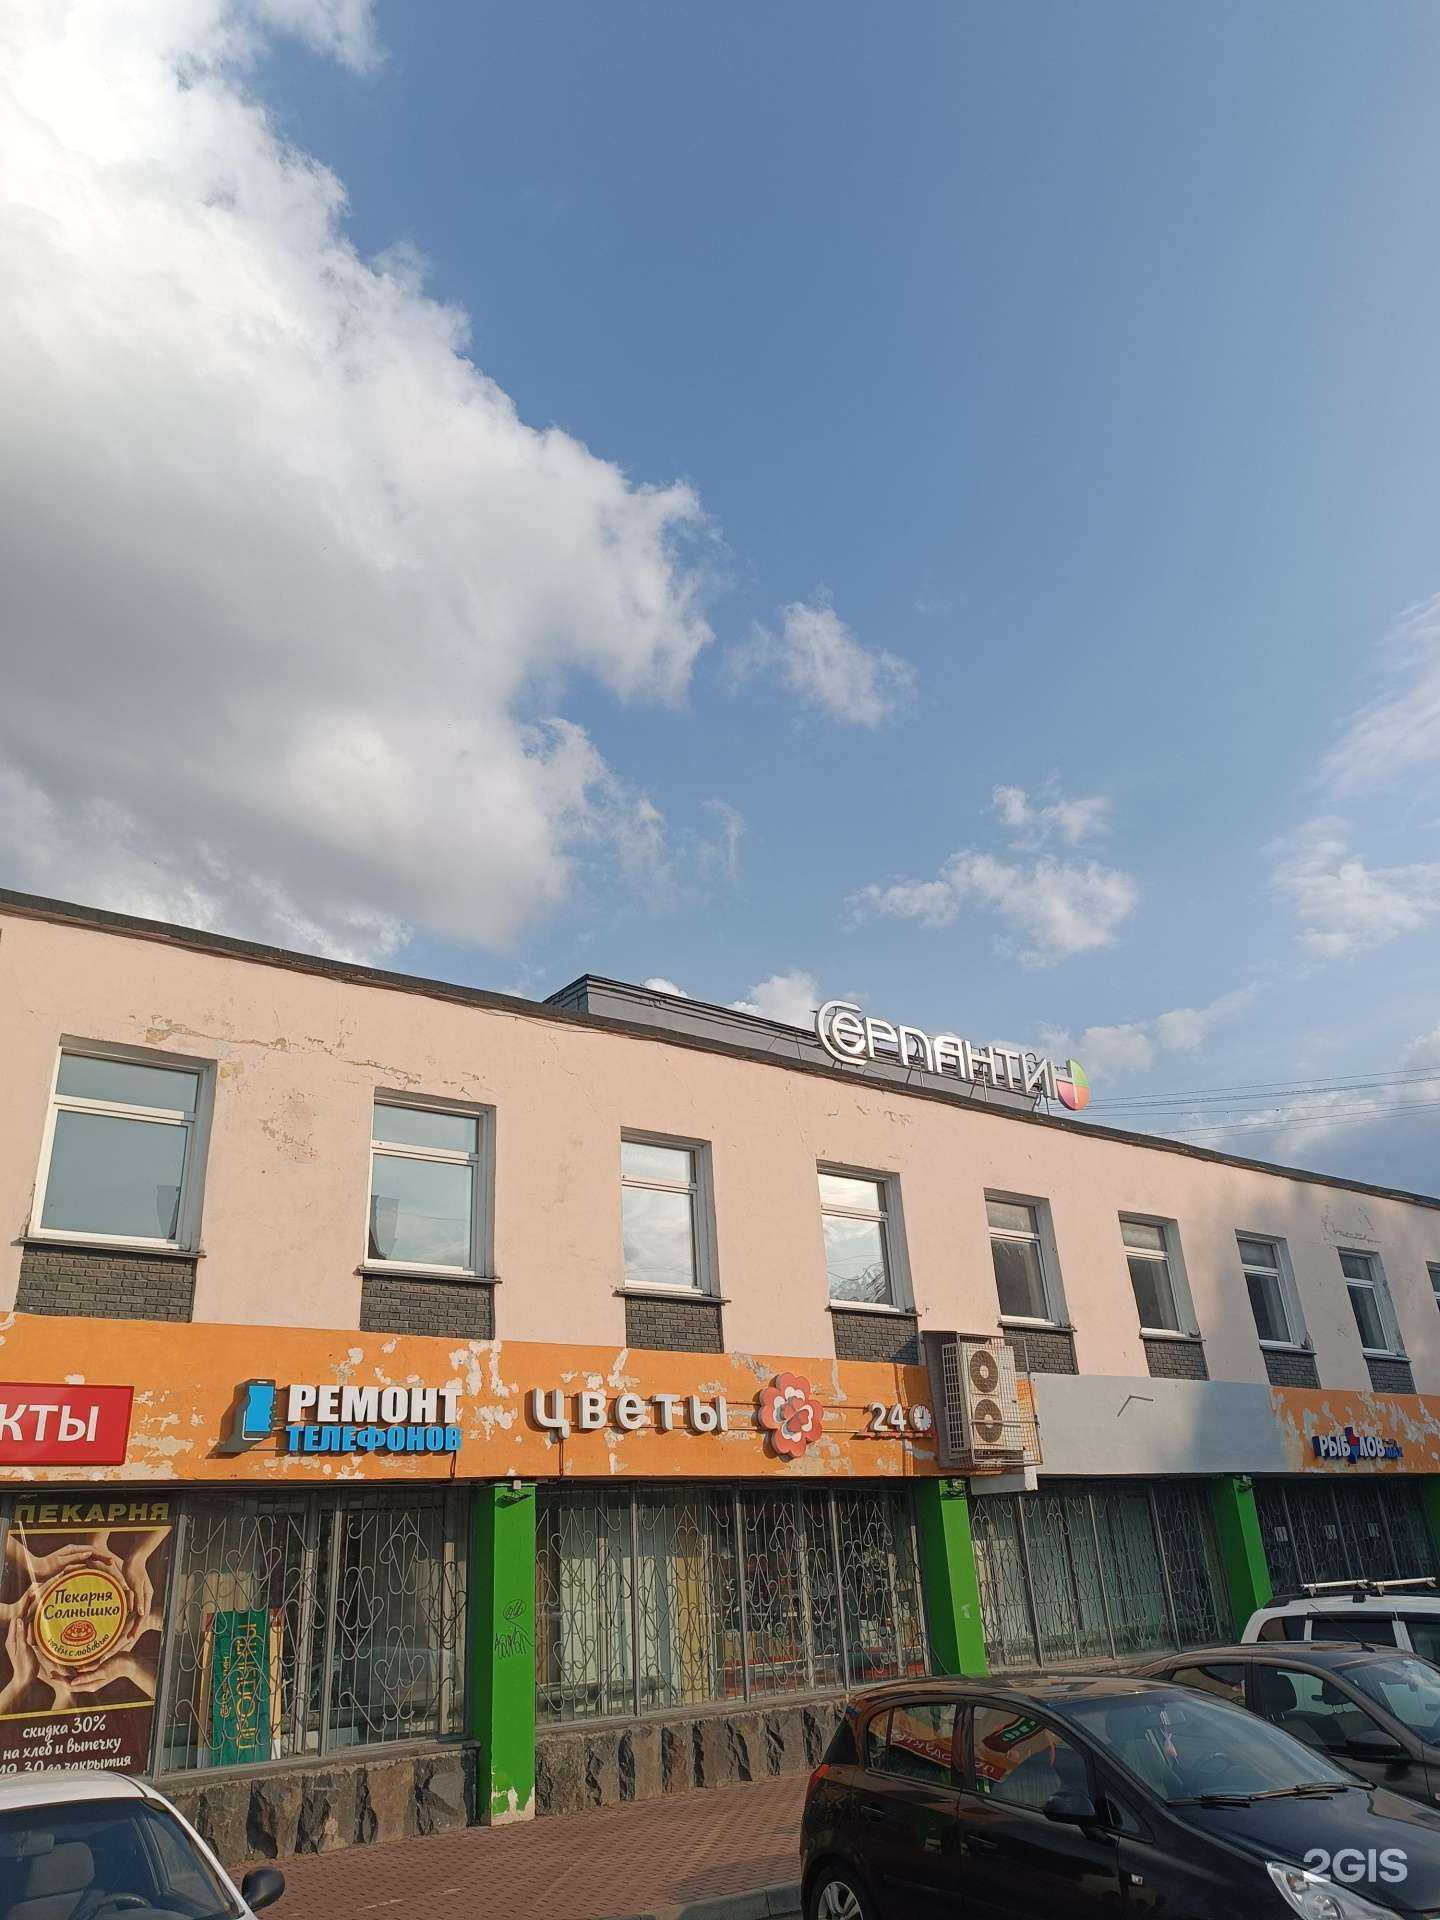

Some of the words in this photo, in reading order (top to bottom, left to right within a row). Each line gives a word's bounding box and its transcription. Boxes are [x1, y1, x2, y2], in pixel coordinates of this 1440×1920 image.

[287, 1384, 462, 1424] РЕМОНТ
[868, 1402, 906, 1432] 24
[286, 1425, 463, 1452] ТЕЛЕФОНОВ
[14, 1503, 169, 1523] ПЕКАРНЯ
[54, 1588, 113, 1606] Пекарня
[44, 1604, 120, 1620] Солнышко
[22, 1724, 69, 1742] скидка
[71, 1714, 107, 1734] 30%
[3, 1748, 20, 1760] на
[22, 1740, 53, 1758] хлеб
[55, 1744, 64, 1754] и
[66, 1738, 122, 1753] выпечку
[64, 1755, 132, 1771] закрытия
